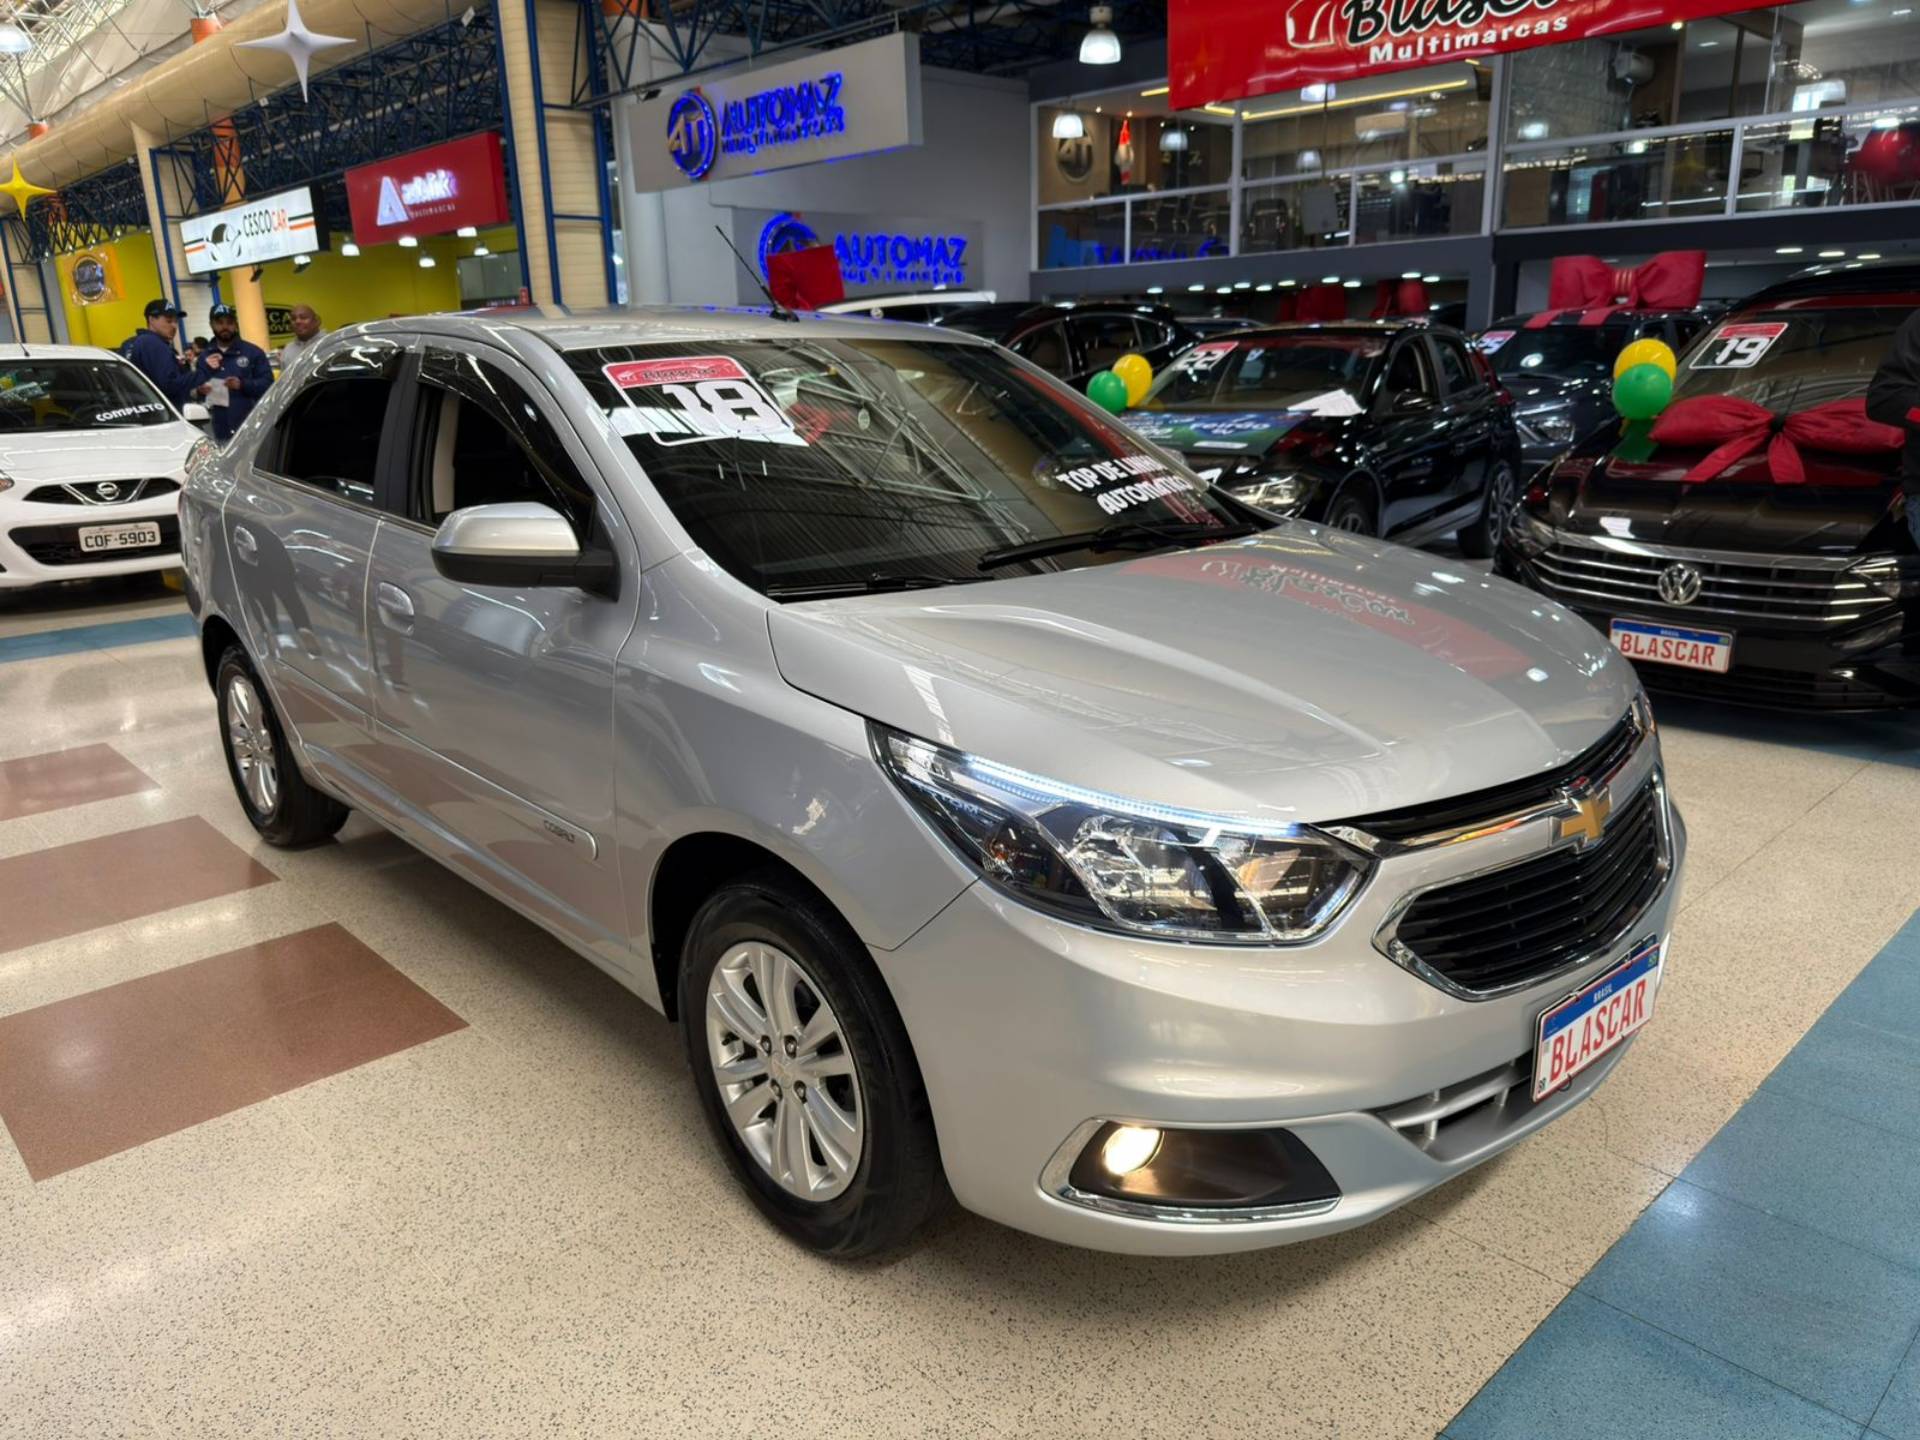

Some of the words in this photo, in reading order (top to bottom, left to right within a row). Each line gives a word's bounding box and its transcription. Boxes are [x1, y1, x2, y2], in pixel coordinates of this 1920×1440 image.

[1369, 16, 1568, 64] Multimarcas
[721, 72, 843, 137] AUTOMAZ
[243, 207, 287, 237] CESCOCAR
[834, 233, 967, 270] AUTOMAZ
[1715, 337, 1770, 365] 19
[95, 401, 166, 422] COMPLETO
[662, 380, 784, 434] 18
[1056, 467, 1101, 492] TOP
[1092, 460, 1129, 482] DE
[1620, 633, 1716, 666] BLASCAR
[1593, 983, 1613, 1003] BRASIL
[1551, 978, 1646, 1081] BLASCAR
